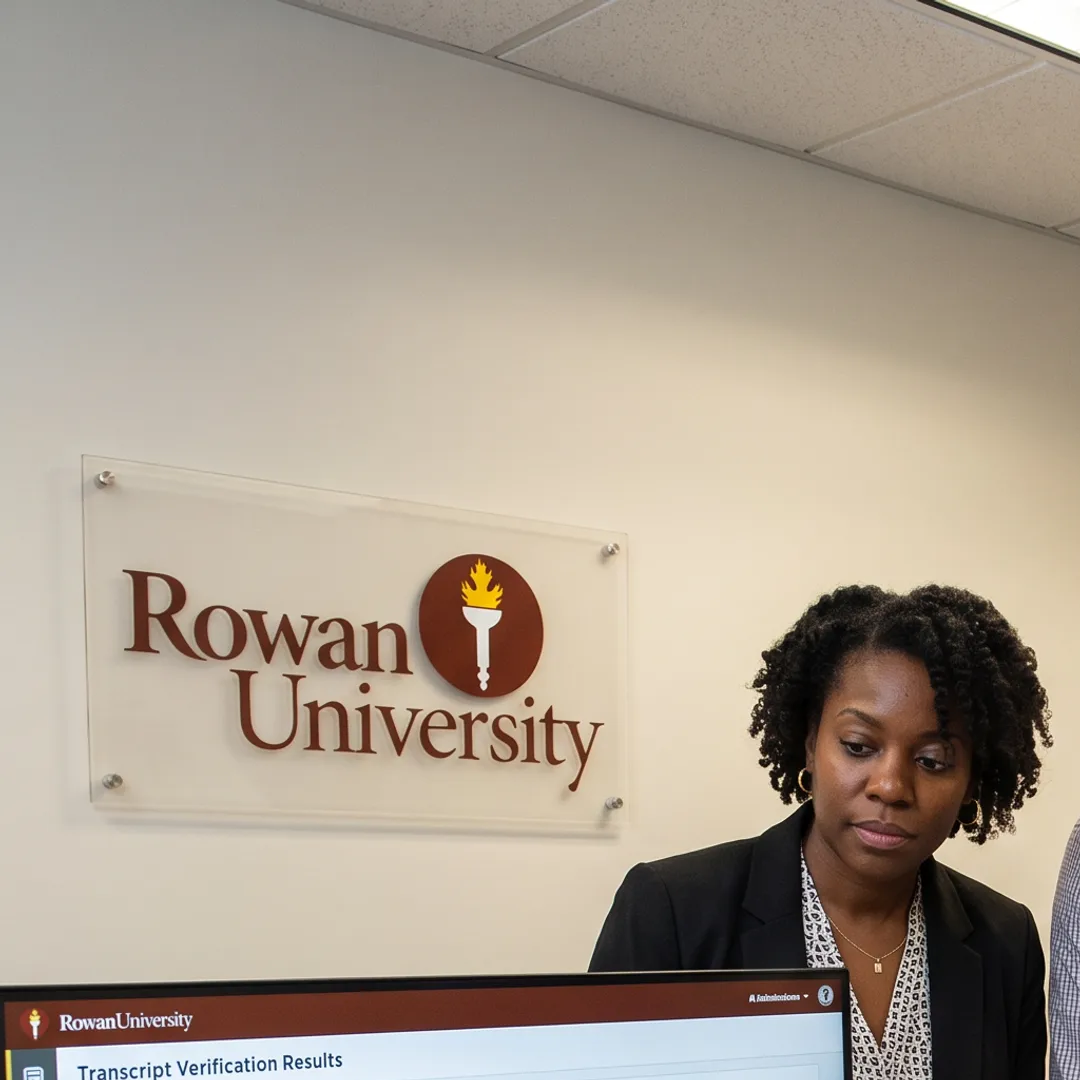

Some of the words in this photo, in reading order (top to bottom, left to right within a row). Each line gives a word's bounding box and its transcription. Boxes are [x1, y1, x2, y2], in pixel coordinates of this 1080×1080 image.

[122, 568, 414, 676] Rowan
[229, 668, 605, 792] University
[176, 1056, 278, 1077] Verification
[283, 1052, 343, 1071] Results
